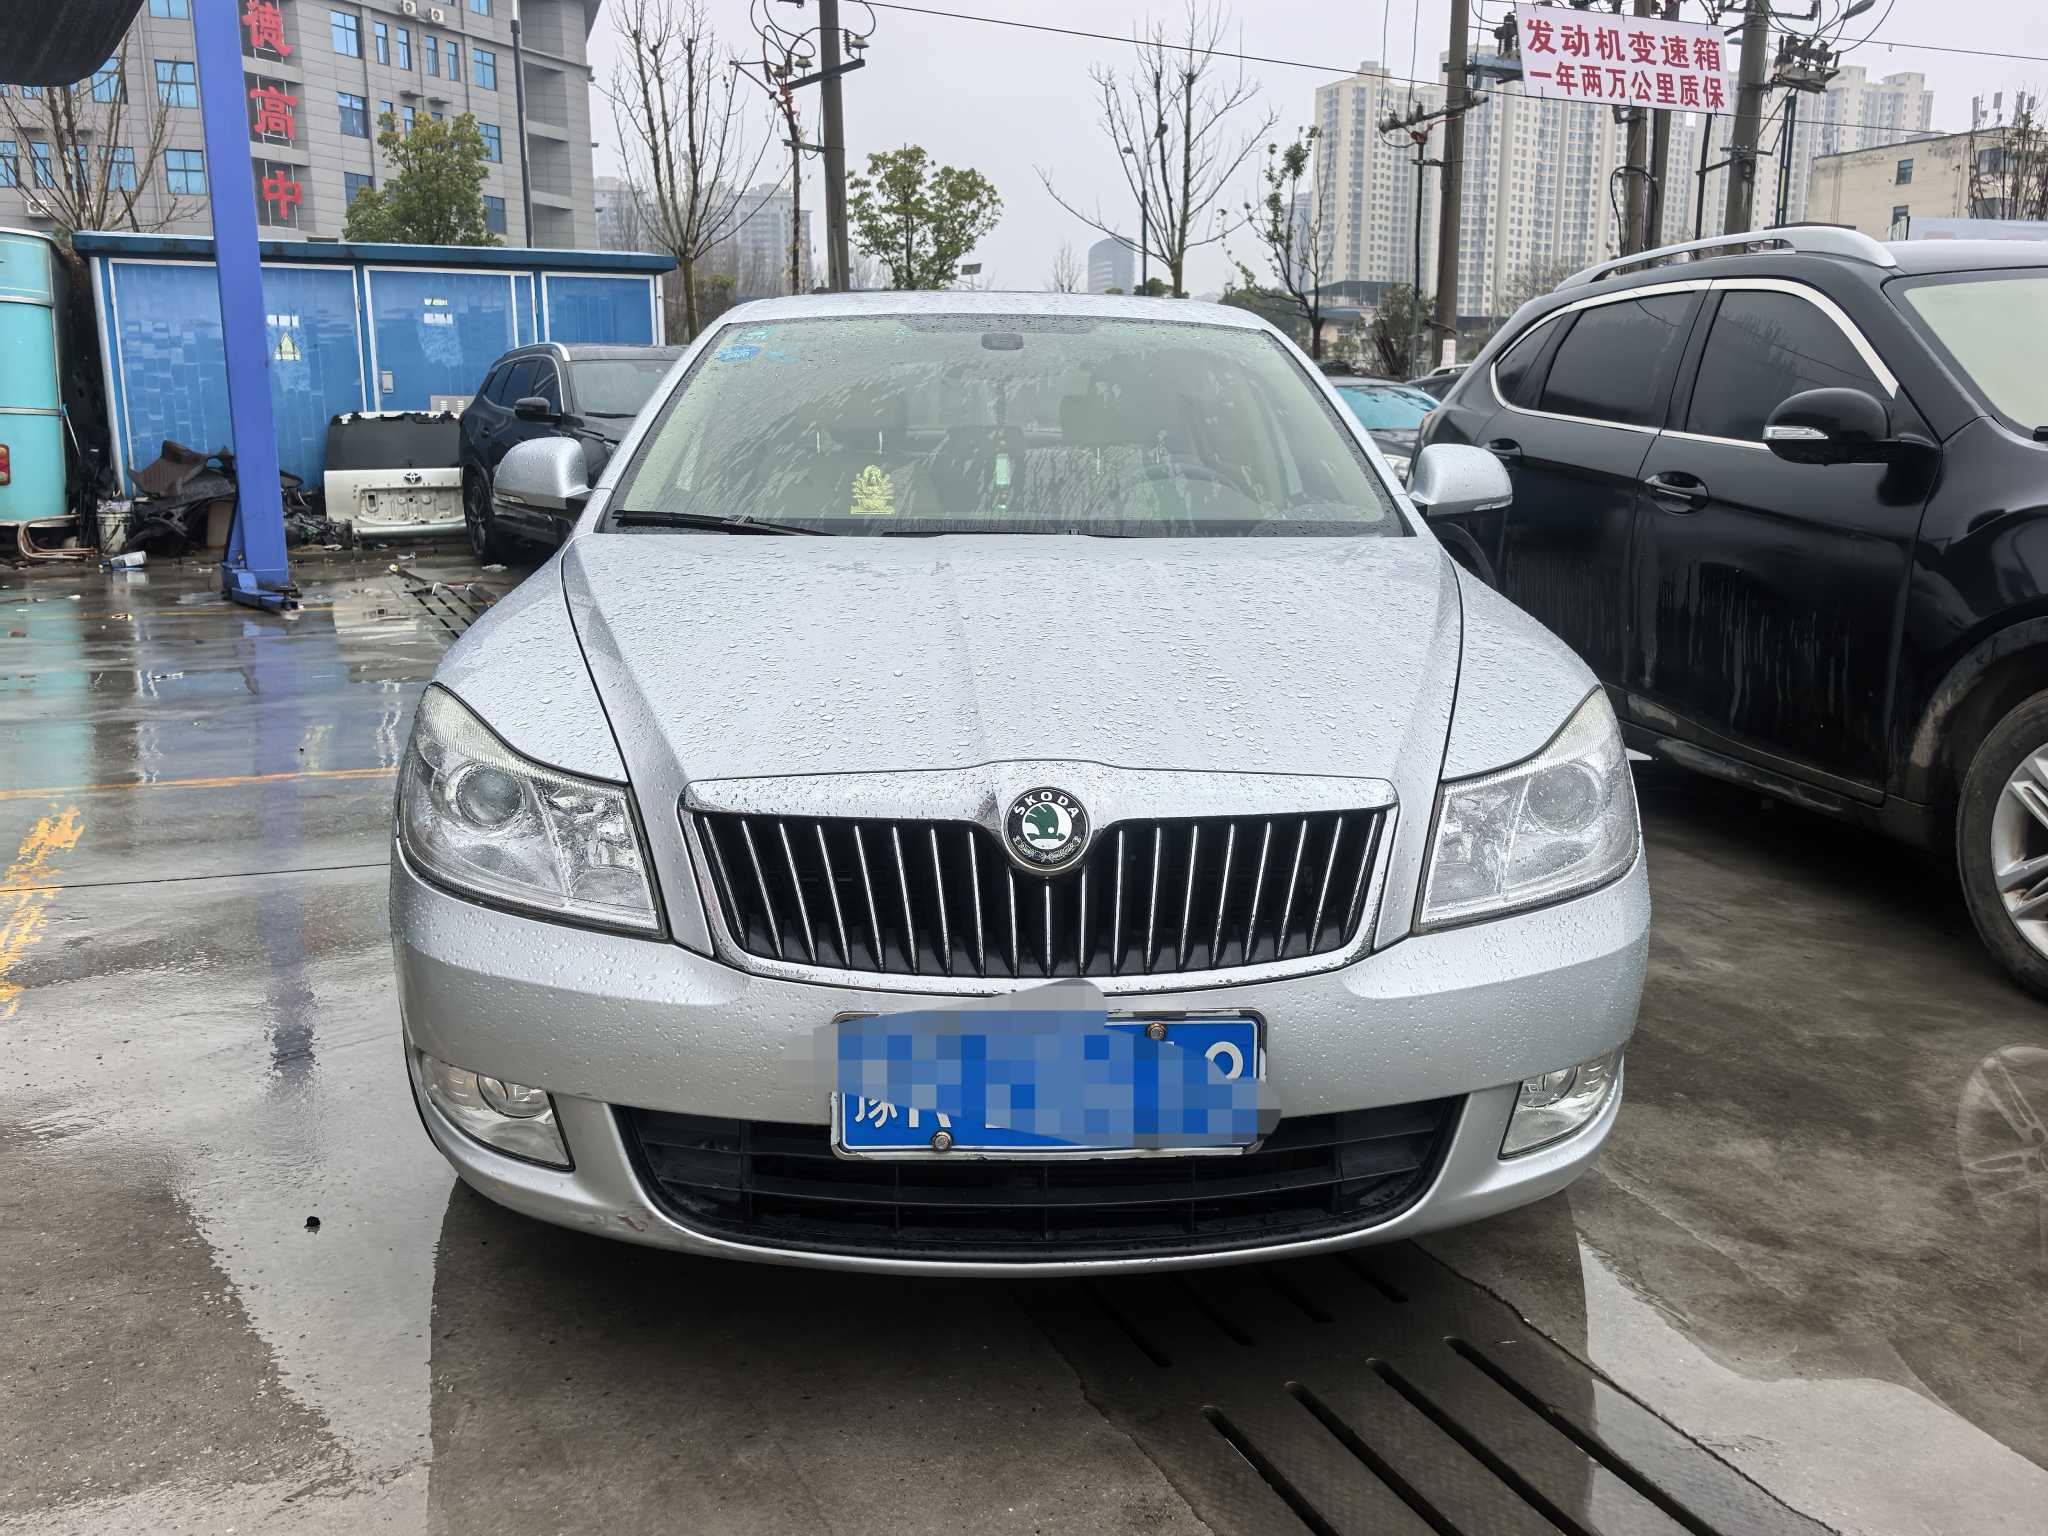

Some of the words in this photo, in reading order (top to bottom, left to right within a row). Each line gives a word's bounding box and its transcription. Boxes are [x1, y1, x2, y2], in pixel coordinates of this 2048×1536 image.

[1526, 19, 1721, 72] 发动机变速箱
[1529, 61, 1725, 109] 一年两万公里质保
